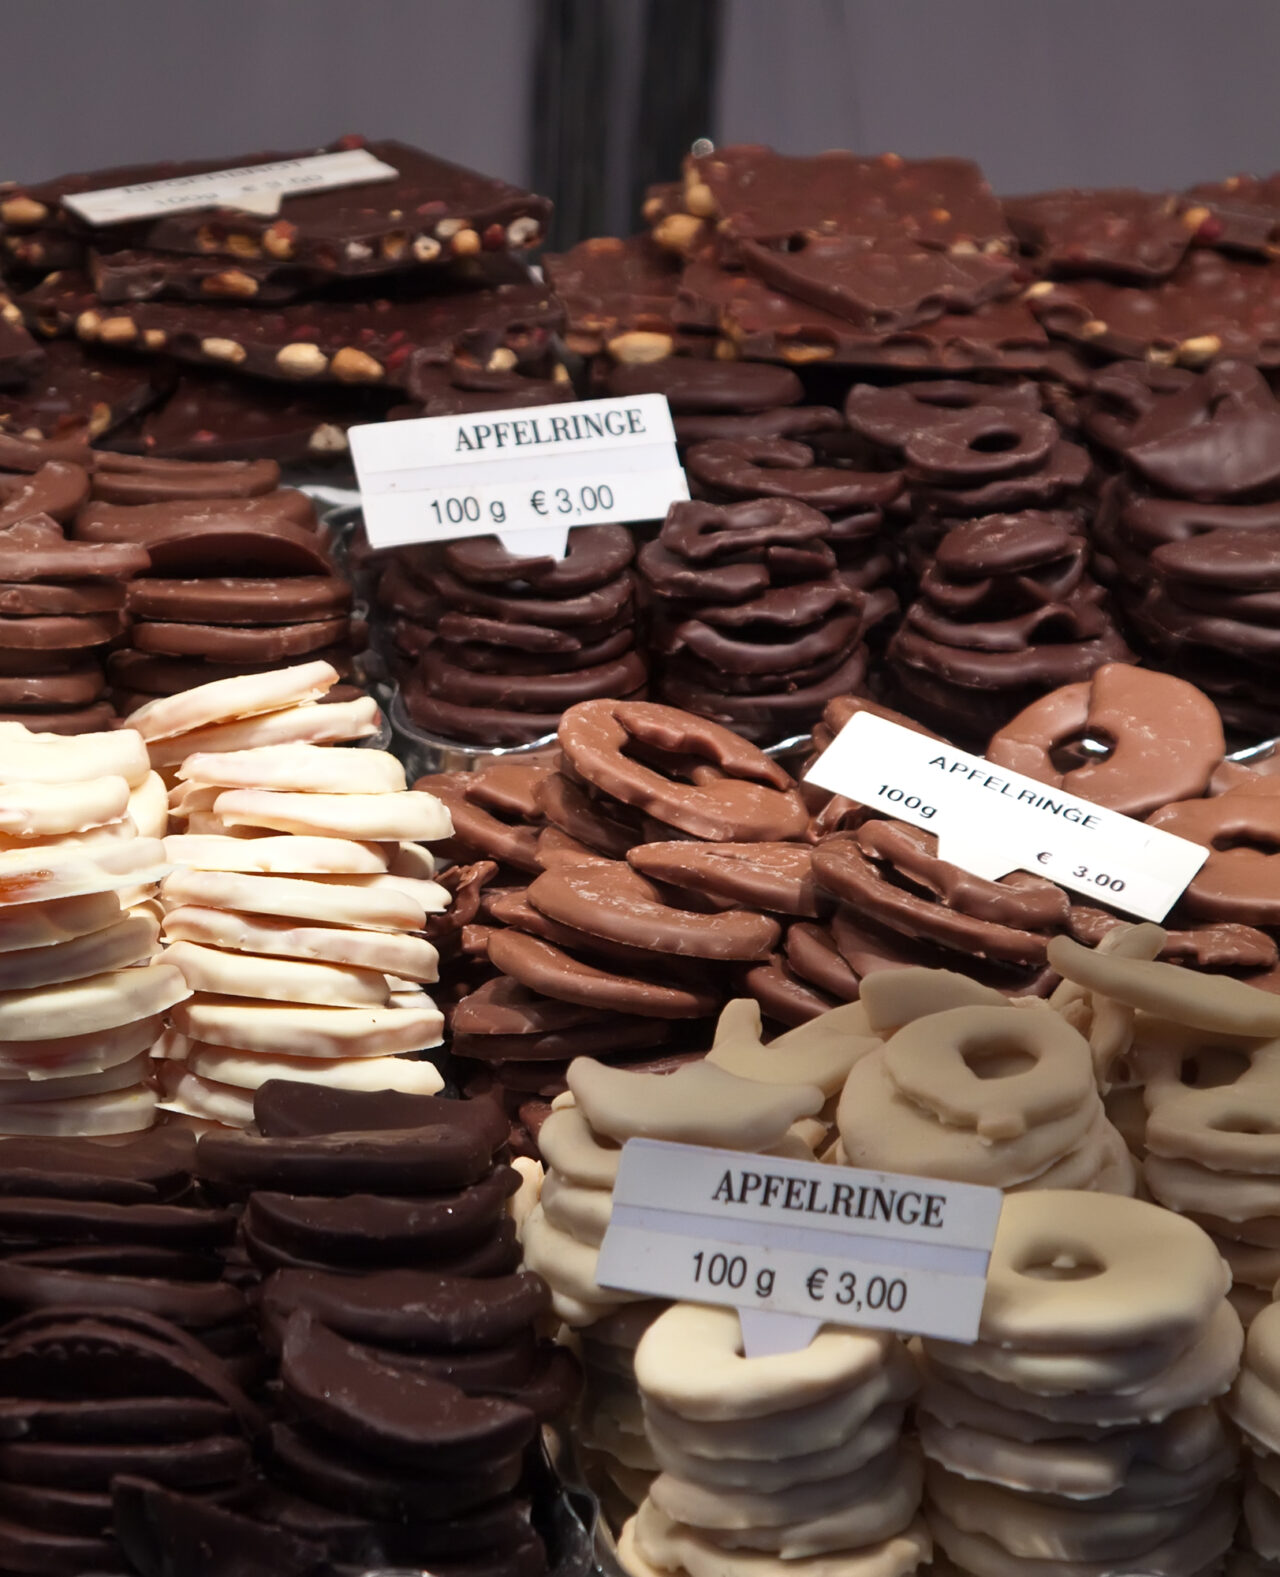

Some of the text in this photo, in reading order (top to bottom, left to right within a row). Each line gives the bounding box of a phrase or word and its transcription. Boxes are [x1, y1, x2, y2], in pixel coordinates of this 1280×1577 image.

[456, 409, 646, 452] APFELRINGE
[431, 485, 614, 525] 100 g € 3,00
[928, 755, 1102, 831] APFELRINGE
[877, 784, 1126, 894] 100g € 3.00
[712, 1169, 947, 1229] APFELRINGE
[692, 1251, 908, 1313] 100 g € 3,00
